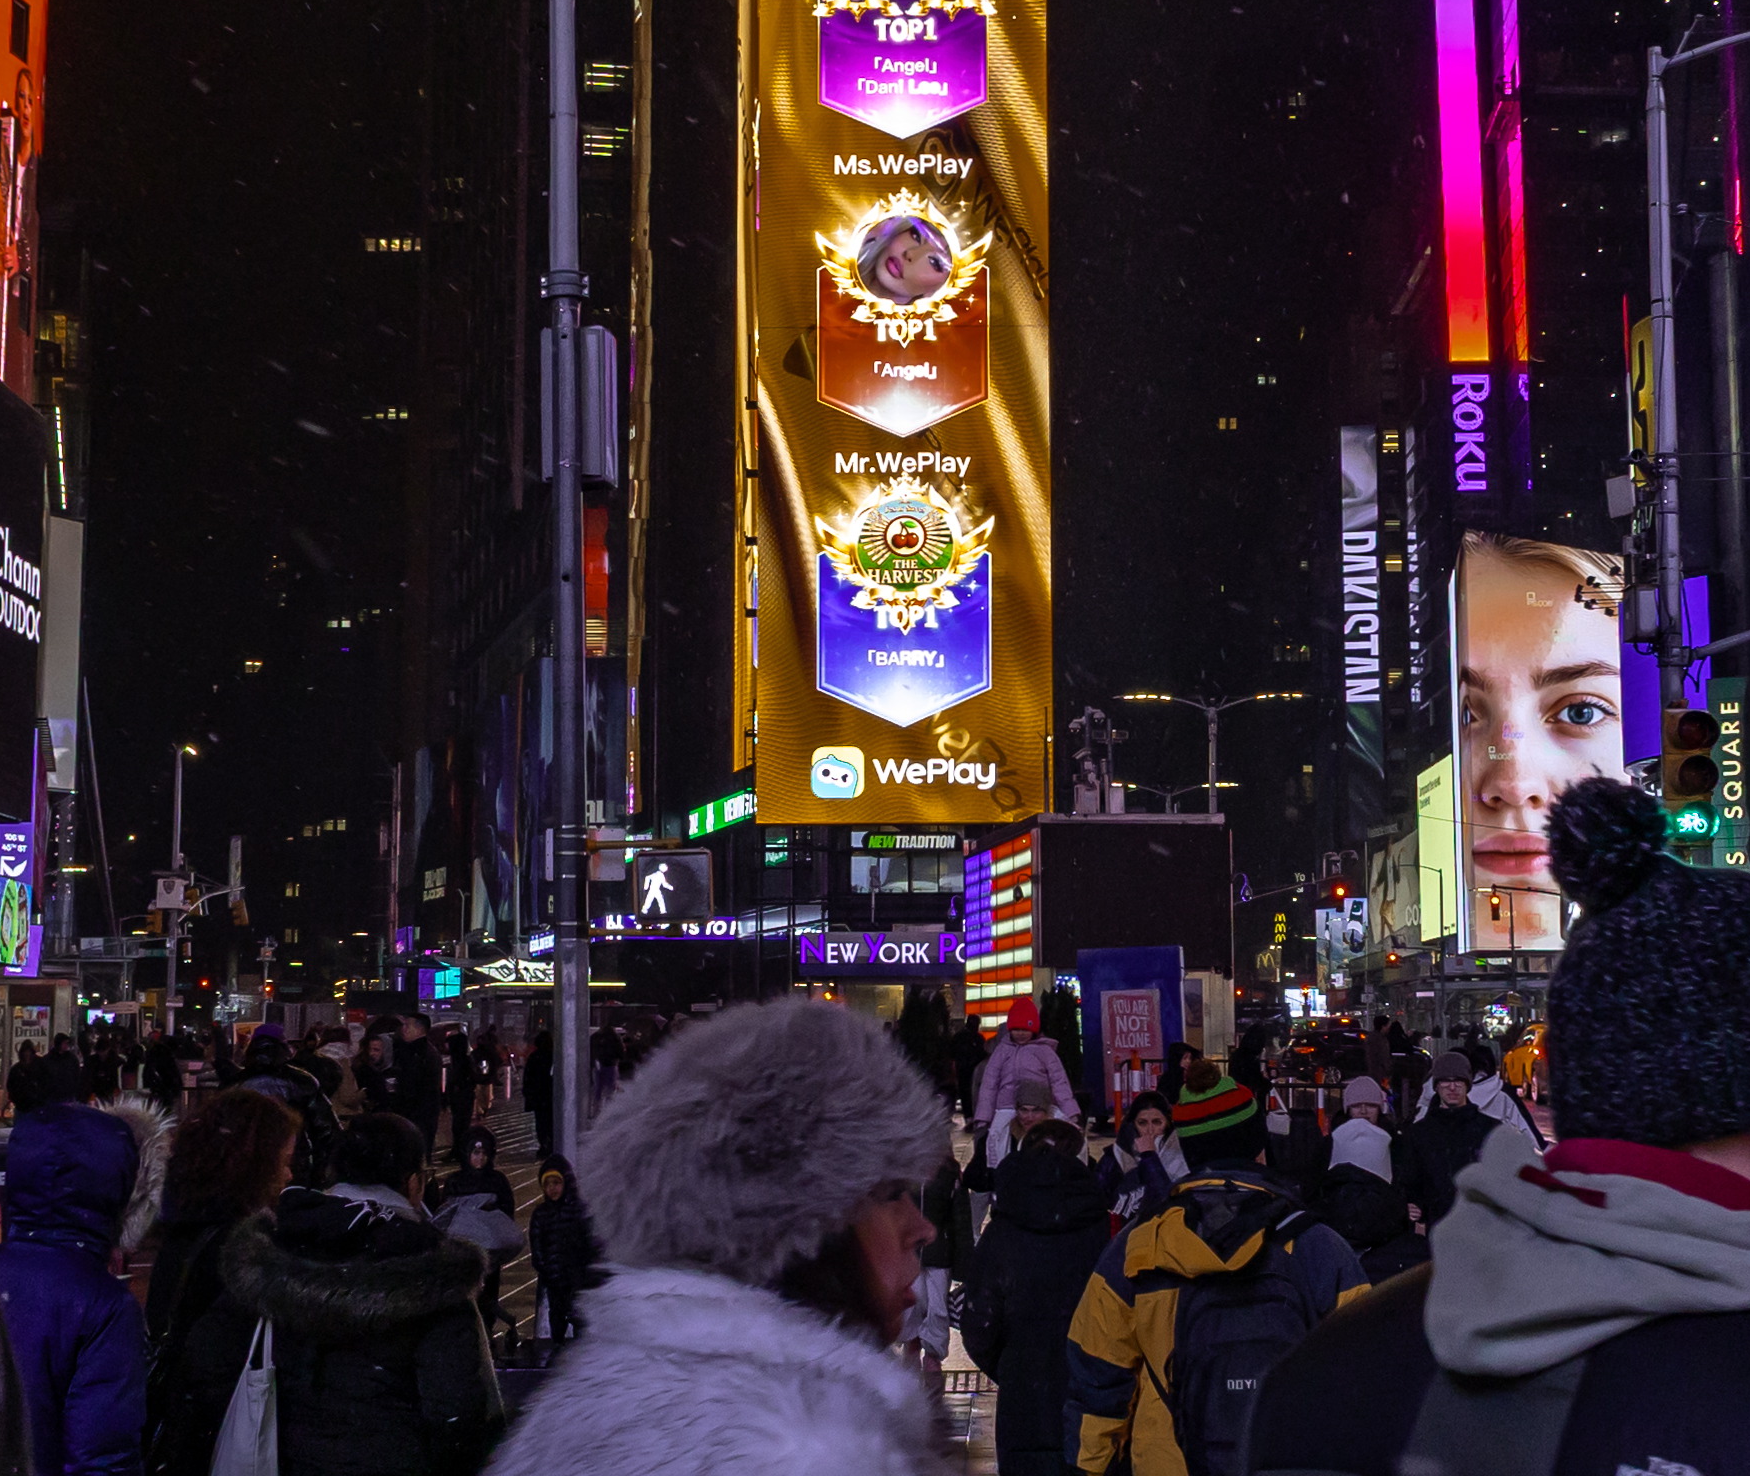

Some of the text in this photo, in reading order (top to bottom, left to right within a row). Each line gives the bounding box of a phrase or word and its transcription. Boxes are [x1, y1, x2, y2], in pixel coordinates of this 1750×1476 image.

[873, 18, 938, 42] TOP1
[833, 154, 973, 179] Ms.WePlay
[873, 319, 938, 342] TOP1
[835, 452, 972, 477] Mr.WePlay
[893, 559, 919, 569] THE
[867, 568, 944, 584] HARVEST
[873, 606, 939, 629] TOP1
[1720, 702, 1744, 819] SQUARE
[872, 758, 997, 790] WePlay
[868, 834, 956, 849] NEWTRADITION
[801, 933, 860, 964] NEW
[863, 933, 931, 964] YORK
[1113, 997, 1149, 1015] YOU ARE
[1116, 1015, 1150, 1033] NOT
[1115, 1033, 1151, 1048] ALONE
